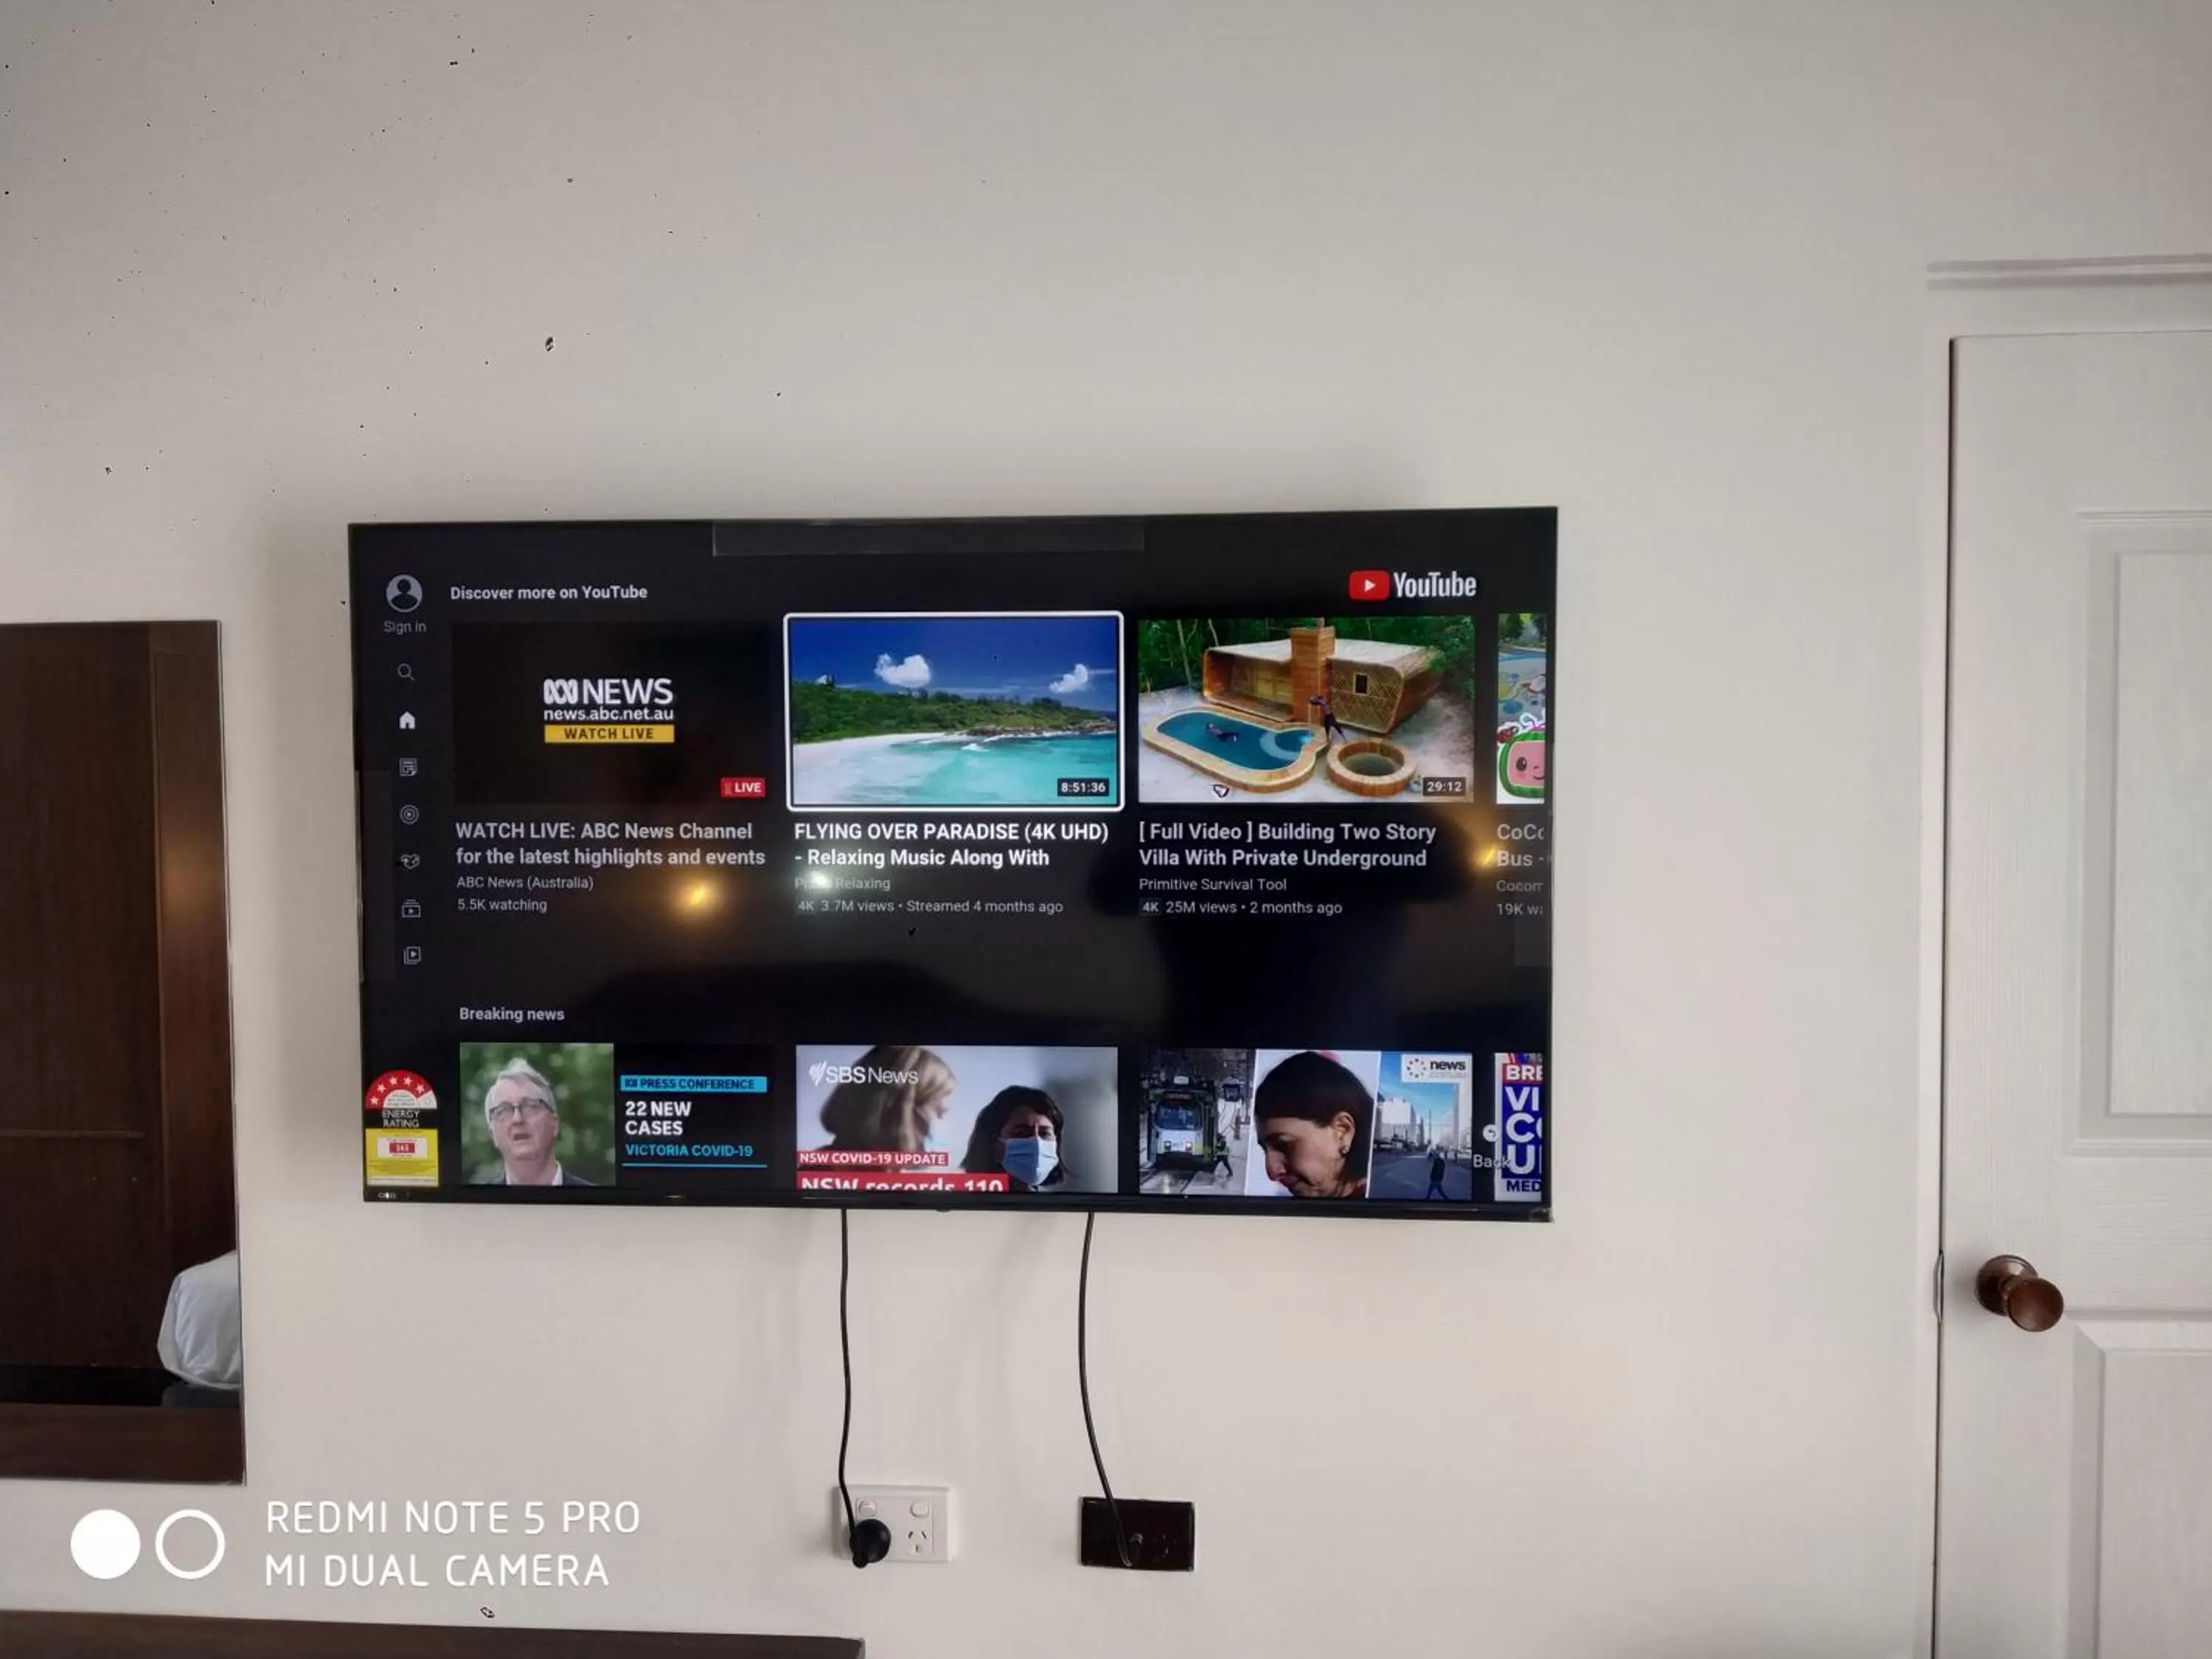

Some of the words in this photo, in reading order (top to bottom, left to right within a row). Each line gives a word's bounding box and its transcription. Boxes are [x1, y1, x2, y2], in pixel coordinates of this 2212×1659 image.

[1393, 571, 1477, 598] YouTube
[451, 585, 514, 600] Discover
[518, 588, 556, 599] more
[560, 588, 578, 599] on
[582, 585, 648, 599] YouTube
[383, 620, 411, 635] Sign
[415, 621, 427, 633] in
[583, 678, 673, 705] NEWS
[543, 707, 674, 720] news.abc.net.au
[564, 728, 617, 740] WATCH
[622, 728, 654, 740] LIVE
[734, 782, 762, 793] LIVE
[1060, 782, 1106, 793] 8:51:36
[1427, 781, 1463, 793] 29:12
[456, 822, 526, 839] WATCH
[529, 822, 576, 839] LIVE:
[581, 822, 620, 839] ABC
[625, 822, 674, 839] News
[678, 821, 753, 840] Channel
[794, 823, 862, 839] FLYING
[867, 823, 918, 839] OVER
[923, 823, 1019, 840] PARADISE
[1024, 822, 1056, 842] (4K
[1061, 822, 1109, 843] UHD)
[1150, 823, 1183, 840] Full
[1188, 823, 1243, 841] Video
[1258, 823, 1335, 843] Building
[1340, 823, 1380, 841] Two
[1386, 823, 1436, 844] Story
[456, 848, 484, 865] for
[487, 848, 515, 865] the
[519, 848, 570, 865] latest
[574, 848, 663, 868] highlights
[667, 848, 700, 866] and
[706, 850, 766, 866] events
[807, 849, 886, 869] Relaxing
[891, 849, 945, 865] Music
[950, 849, 1004, 869] Along
[1009, 849, 1050, 866] With
[1139, 849, 1180, 866] Villa
[1185, 849, 1227, 866] With
[1232, 849, 1298, 866] Private
[1304, 849, 1427, 869] Underground
[1498, 850, 1533, 866] Bus
[456, 877, 484, 889] ABC
[487, 877, 524, 889] News
[526, 875, 594, 891] (Australia)
[835, 877, 891, 891] Relaxing
[1139, 877, 1198, 891] Primitive
[1201, 877, 1253, 891] Survival
[1256, 877, 1287, 891] Tool
[457, 899, 486, 911] 5.5K
[489, 898, 548, 914] watching
[820, 900, 854, 912] 37M
[858, 900, 895, 912] views
[906, 899, 970, 913] Streamed
[973, 900, 981, 912] 4
[985, 900, 1035, 913] months
[1039, 902, 1063, 915] ago
[1142, 902, 1159, 913] 4K
[1166, 901, 1196, 914] 25M
[1199, 901, 1238, 914] views
[1250, 901, 1259, 914] 2
[1262, 900, 1312, 914] months
[1317, 903, 1343, 917] ago
[1498, 903, 1524, 915] 19K
[459, 1007, 524, 1023] Breaking
[527, 1009, 566, 1021] news
[1430, 1061, 1466, 1071] news
[825, 1065, 866, 1083] SBS
[869, 1067, 919, 1085] News
[641, 1079, 676, 1089] PRESS
[678, 1079, 755, 1090] CONFERENCE
[381, 1110, 420, 1119] ENERGY
[625, 1101, 647, 1116] 22
[650, 1101, 692, 1116] NEW
[383, 1119, 420, 1128] RATING
[625, 1120, 684, 1135] CASES
[1506, 1112, 1542, 1143] C
[625, 1144, 689, 1157] VICTORIA
[692, 1144, 754, 1158] COVID-19
[799, 1152, 830, 1164] NSW
[832, 1152, 892, 1164] COVID-19
[895, 1154, 946, 1166] UPDATE
[1474, 1153, 1511, 1169] Back
